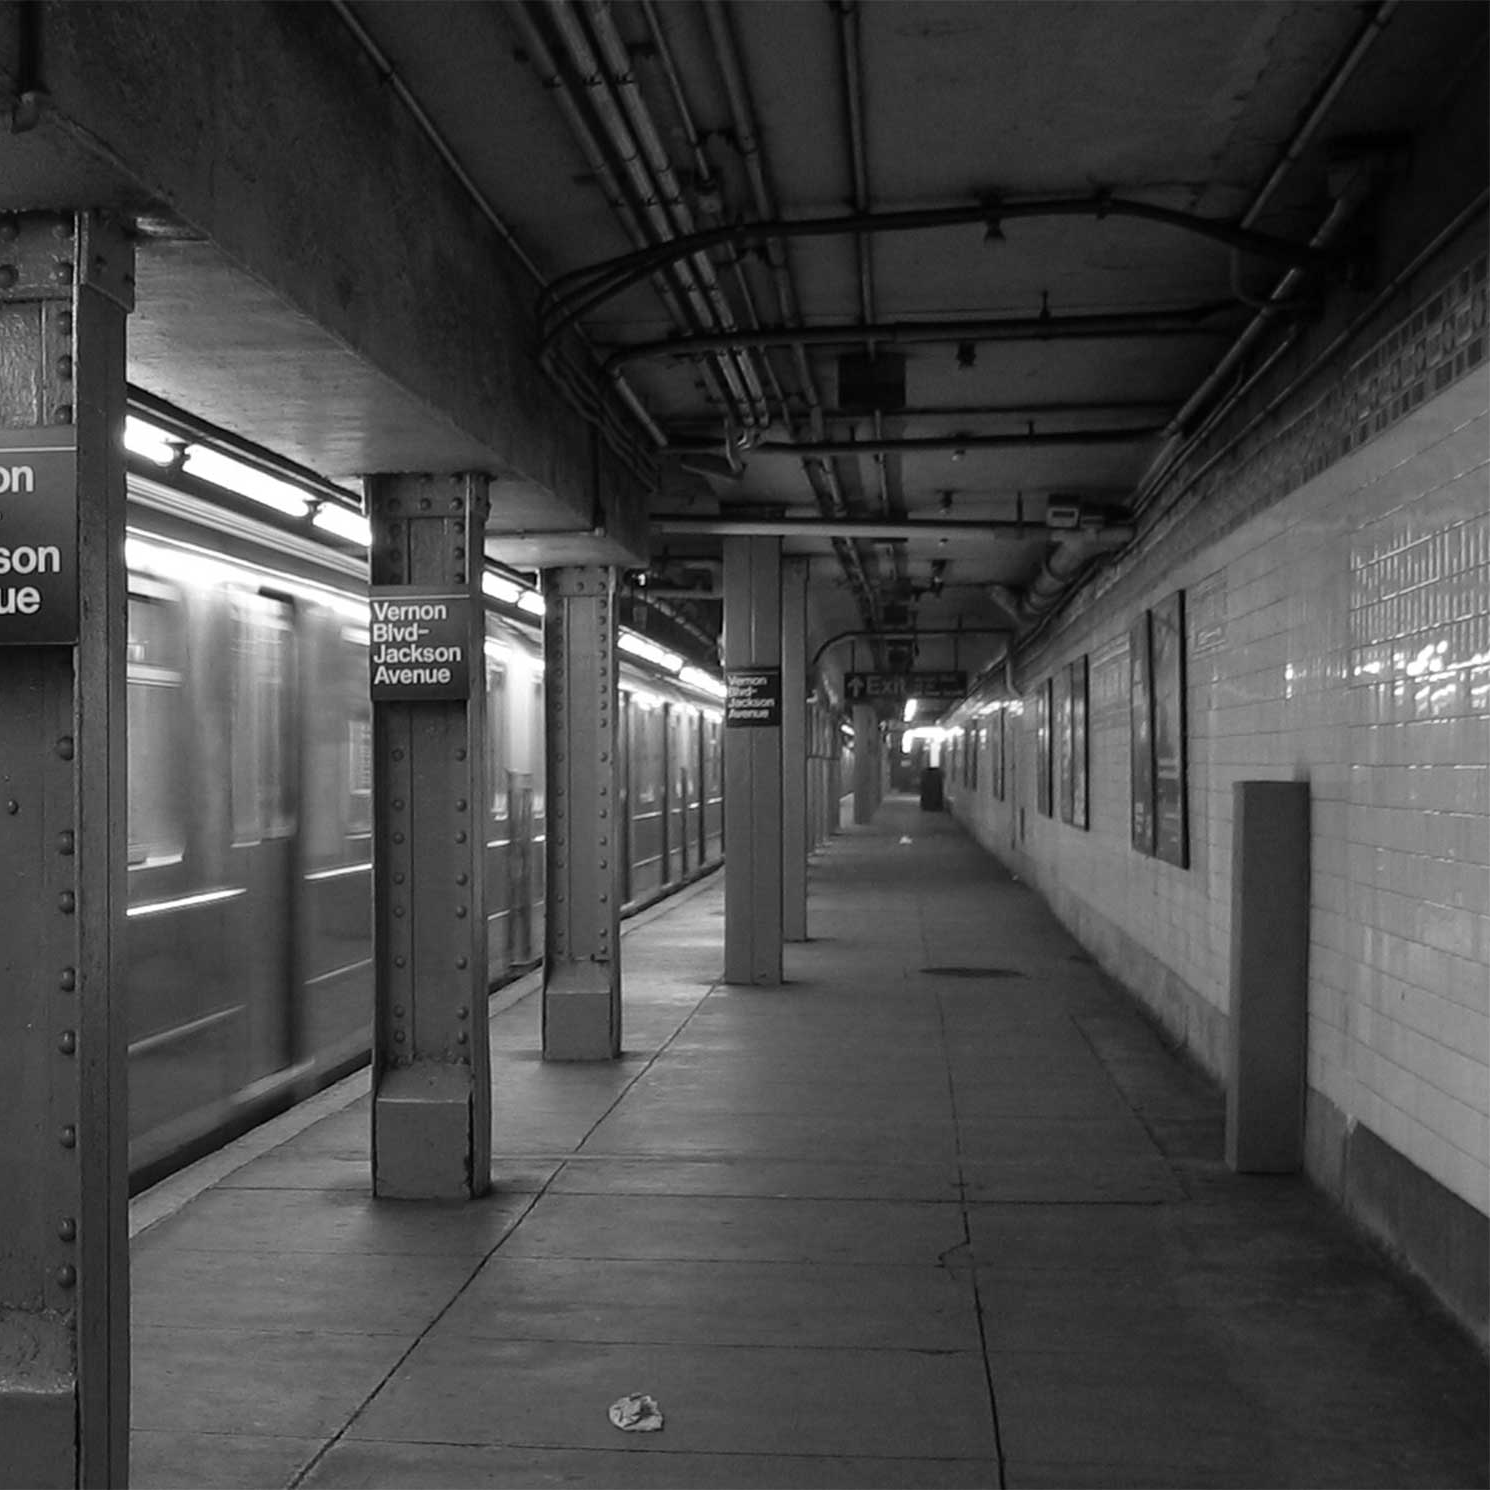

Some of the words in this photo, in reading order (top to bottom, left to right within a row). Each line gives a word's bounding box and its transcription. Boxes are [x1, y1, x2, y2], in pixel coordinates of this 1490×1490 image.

[373, 601, 447, 621] Vernon
[373, 643, 462, 664] Jackson
[373, 665, 452, 685] Avenue
[727, 675, 768, 686] Vernon
[727, 697, 775, 708] Jackson
[728, 708, 770, 719] Avenue
